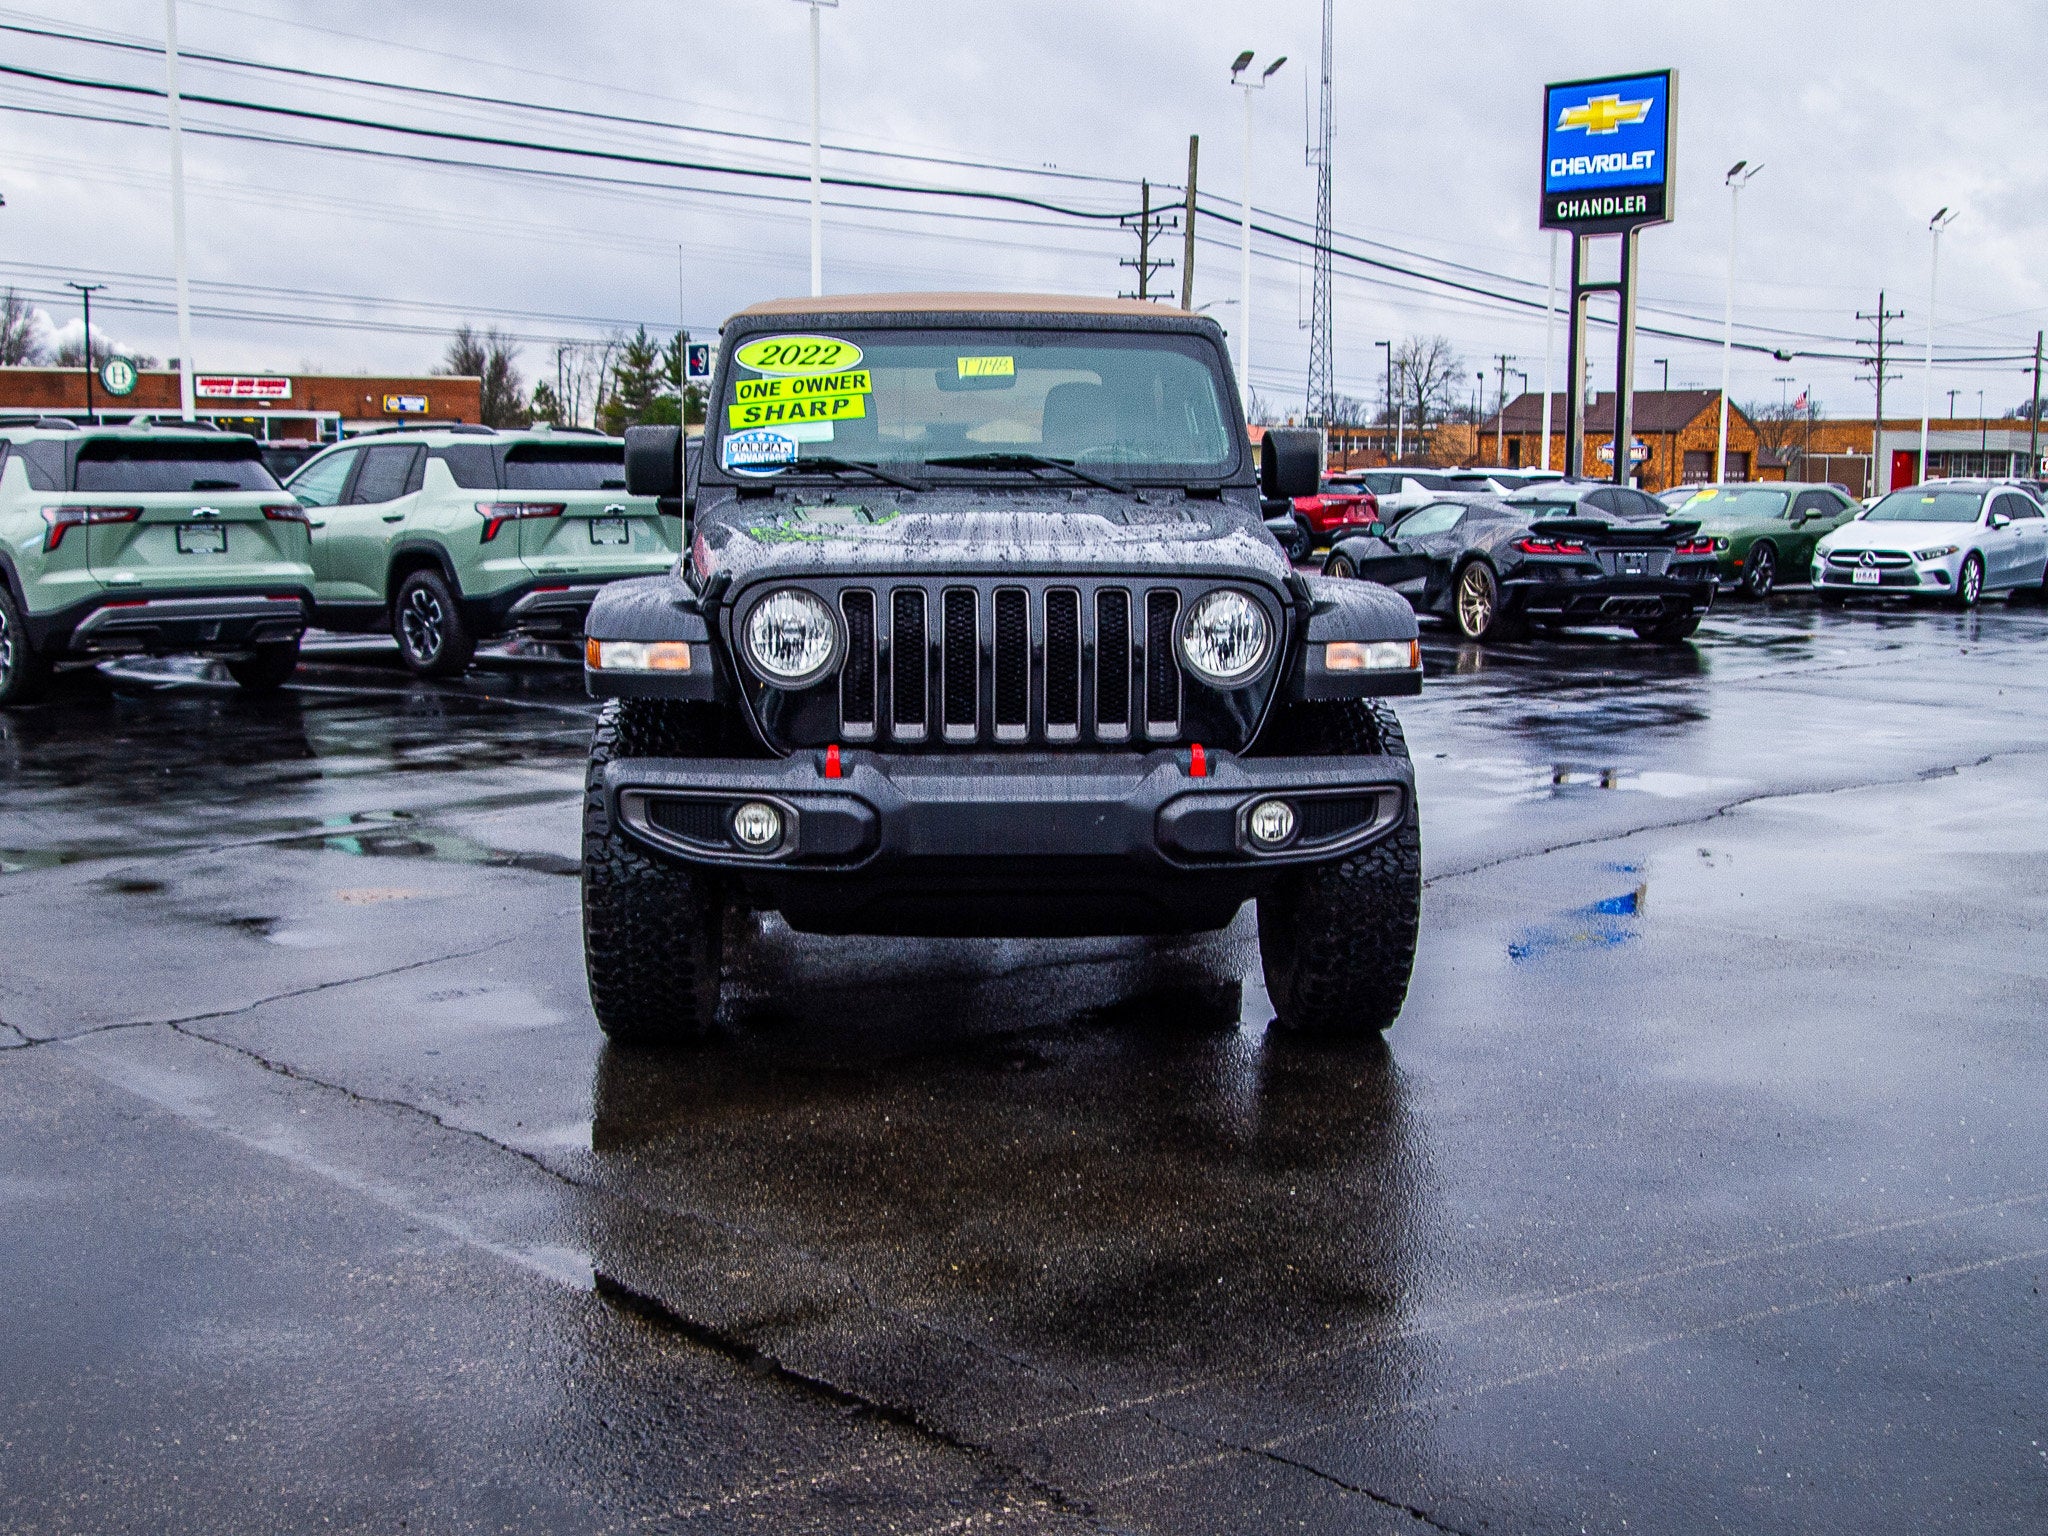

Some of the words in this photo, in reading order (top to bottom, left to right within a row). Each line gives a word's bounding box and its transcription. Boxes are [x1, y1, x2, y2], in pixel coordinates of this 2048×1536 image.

[1550, 149, 1656, 178] CHEVROLET
[1557, 195, 1647, 218] CHANDLER
[757, 344, 842, 366] 2022
[739, 381, 782, 399] ONE
[792, 374, 866, 394] OWNER
[743, 398, 850, 423] SHARP
